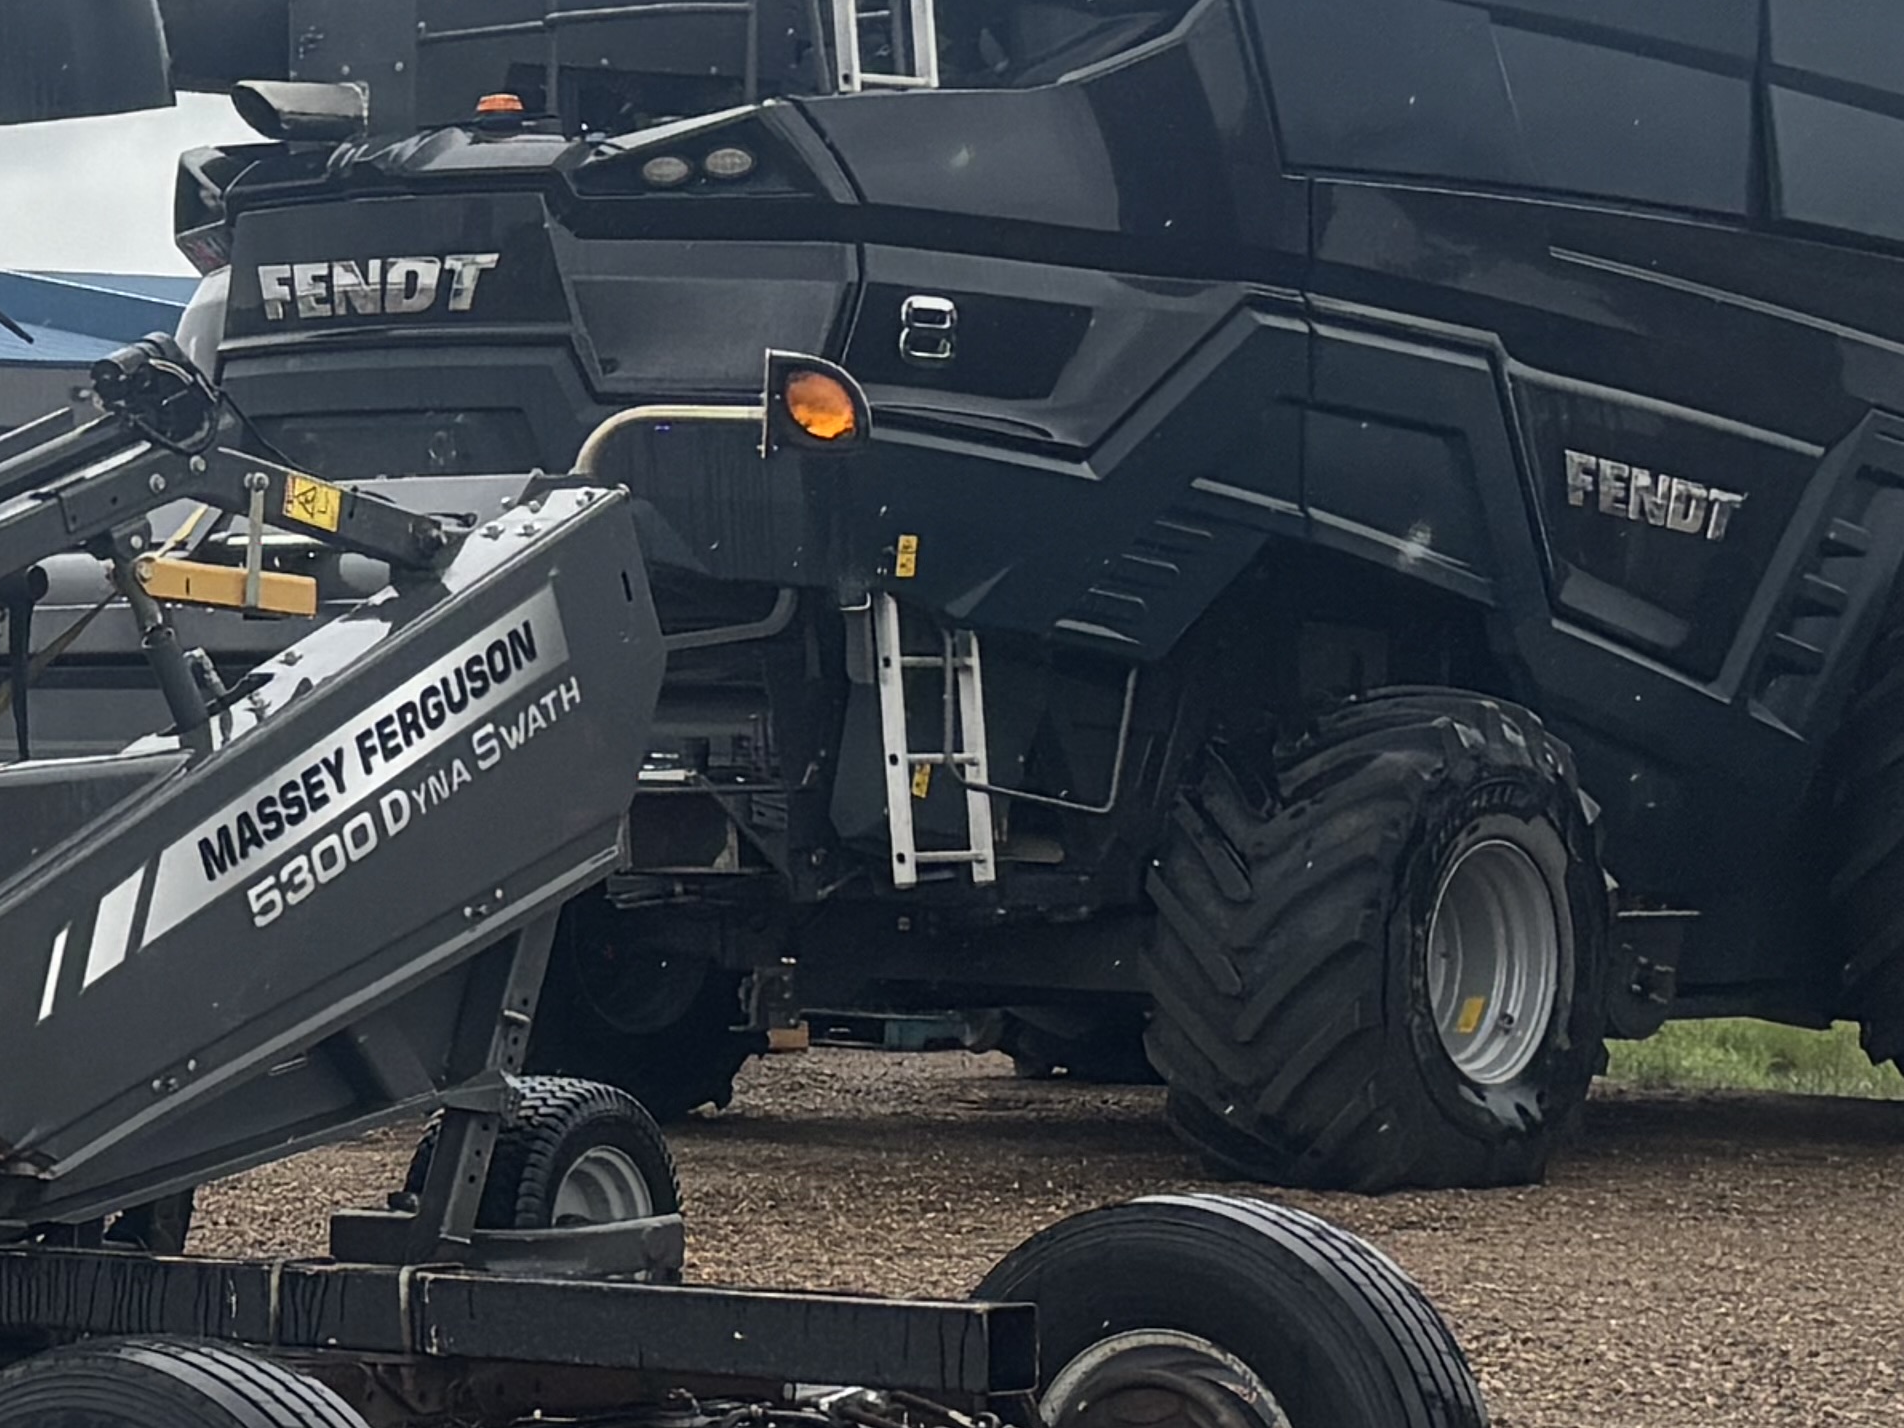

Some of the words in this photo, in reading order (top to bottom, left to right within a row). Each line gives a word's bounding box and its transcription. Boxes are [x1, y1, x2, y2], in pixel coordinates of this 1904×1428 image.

[258, 253, 499, 320] FENDT
[1565, 449, 1749, 541] FENDT
[198, 746, 346, 882] MASSEY
[355, 619, 538, 776] FERGUSON
[247, 811, 379, 928] 5300
